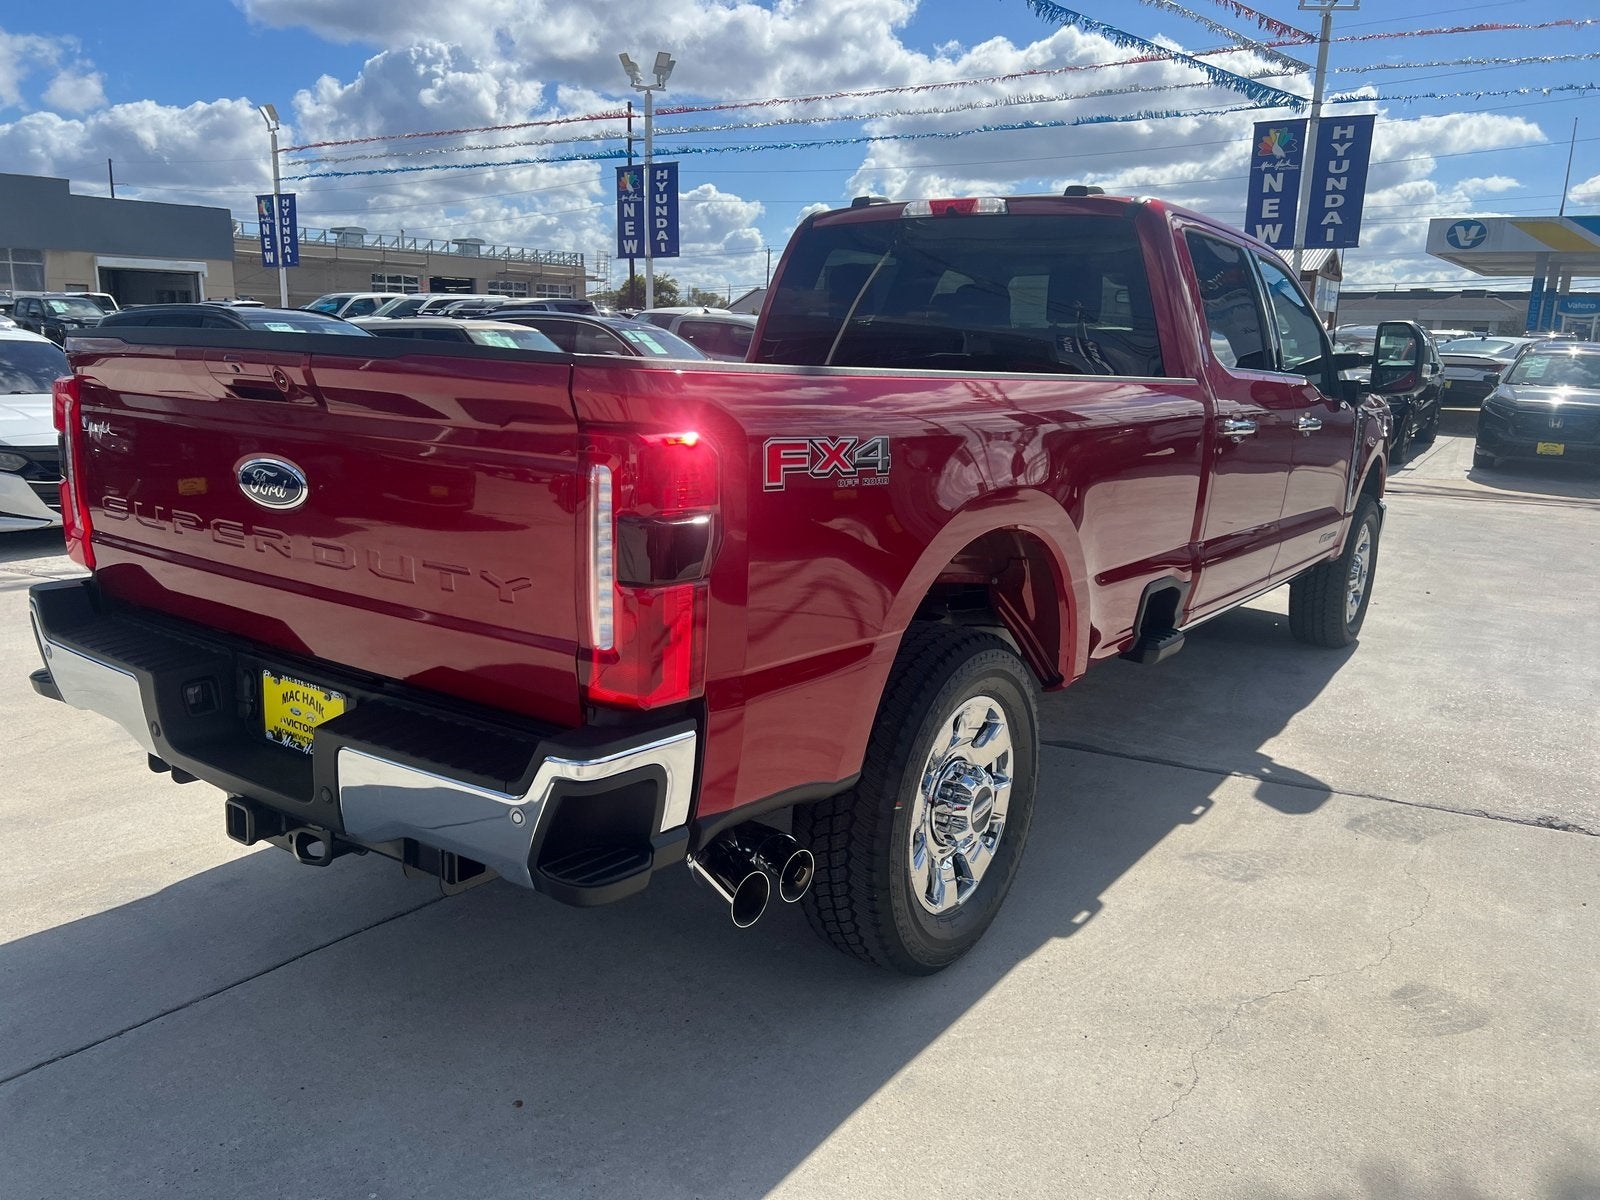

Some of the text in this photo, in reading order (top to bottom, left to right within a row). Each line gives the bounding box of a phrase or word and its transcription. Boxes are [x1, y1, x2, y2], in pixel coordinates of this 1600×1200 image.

[1255, 172, 1284, 243] NEW
[1321, 125, 1355, 242] HYUNDAI
[281, 198, 292, 263] HYUNDAI
[622, 202, 638, 254] NEW
[655, 169, 669, 253] HYUNDAI
[262, 223, 274, 263] NEW
[1567, 301, 1597, 309] Valero
[250, 468, 288, 498] Ford
[763, 436, 892, 492] FX4
[837, 476, 889, 488] OFF ROAD
[101, 494, 533, 605] SUPER DUTY
[282, 690, 325, 719] MAC HAIK
